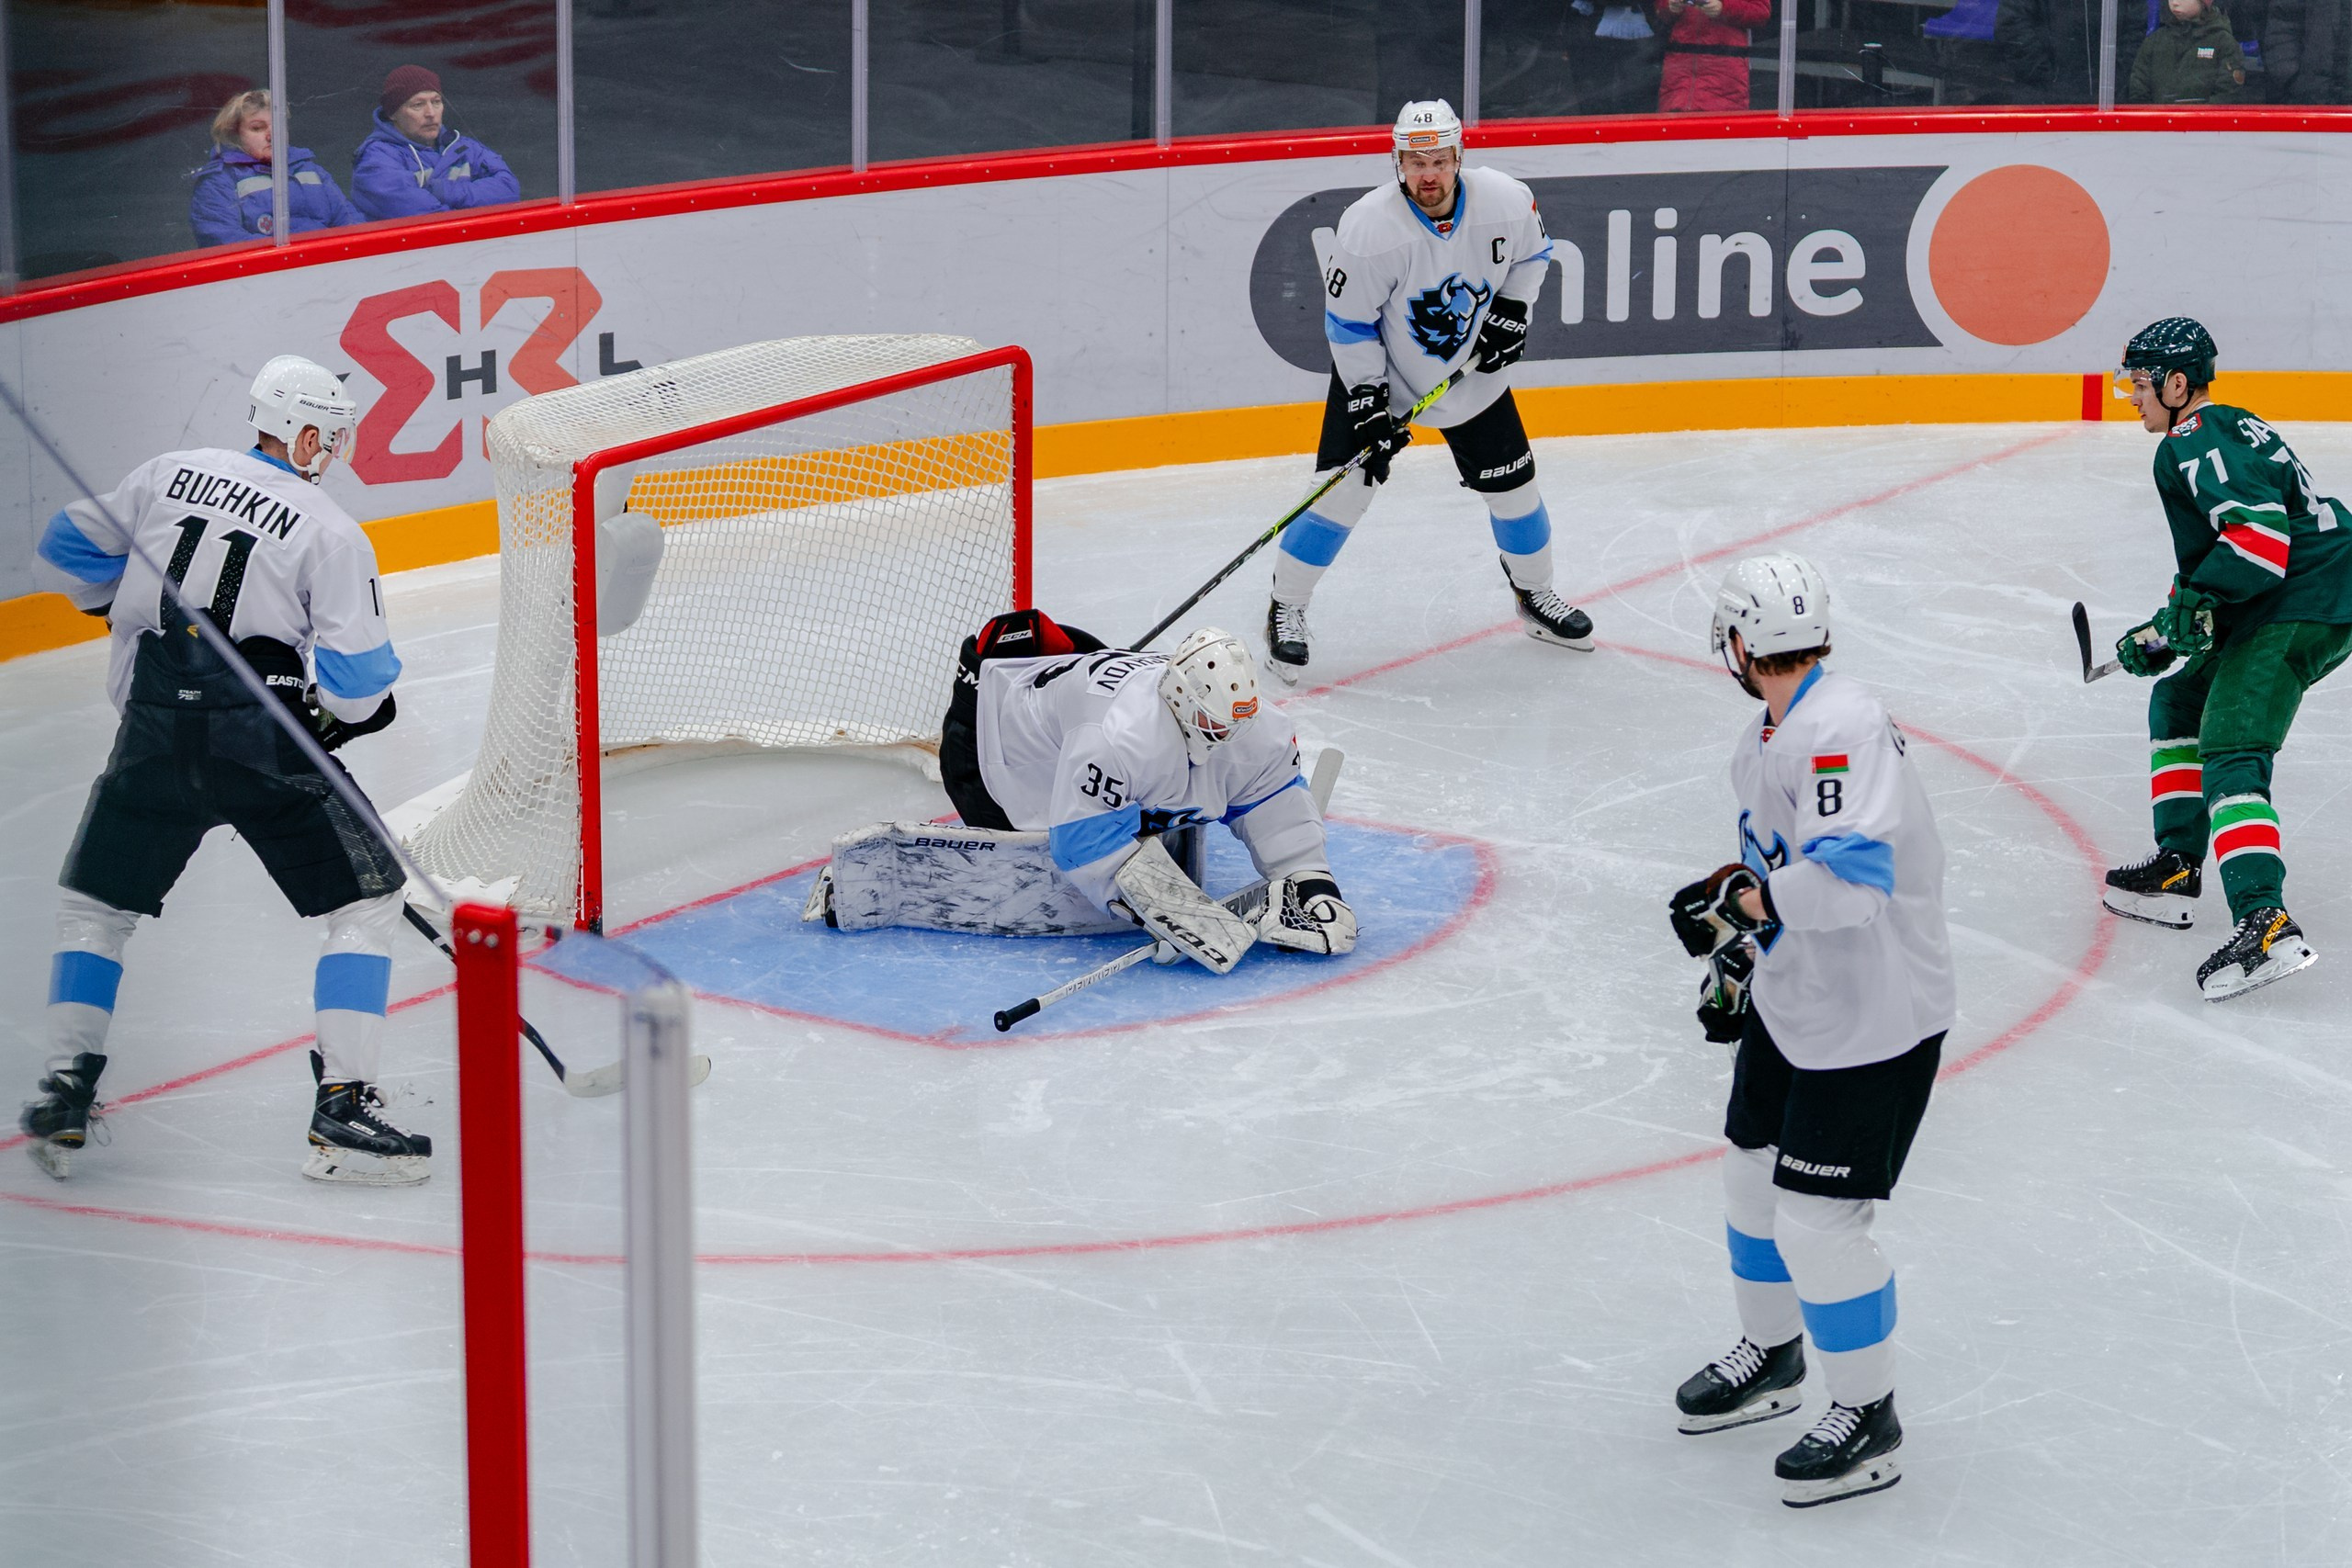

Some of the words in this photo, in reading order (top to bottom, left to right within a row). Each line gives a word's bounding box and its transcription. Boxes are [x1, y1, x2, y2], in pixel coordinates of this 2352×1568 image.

[1413, 113, 1432, 123] 48
[1491, 236, 1507, 265] C
[1312, 207, 1866, 326] nline
[1484, 312, 1527, 334] UER
[300, 399, 329, 412] BAUER
[1479, 450, 1533, 479] BAUER
[2178, 447, 2229, 498] 71
[166, 468, 301, 540] BUCHKIN
[159, 514, 259, 638] 11
[368, 578, 386, 618] 1
[1792, 595, 1804, 615] 8
[1001, 631, 1029, 641] CCM
[266, 674, 304, 689] EASTO
[1080, 761, 1126, 808] 35
[1816, 778, 1843, 818] 8
[914, 837, 996, 852] BAUER
[1153, 915, 1228, 966] CCM
[2266, 917, 2285, 943] CCM
[1780, 1154, 1851, 1179] BAUER
